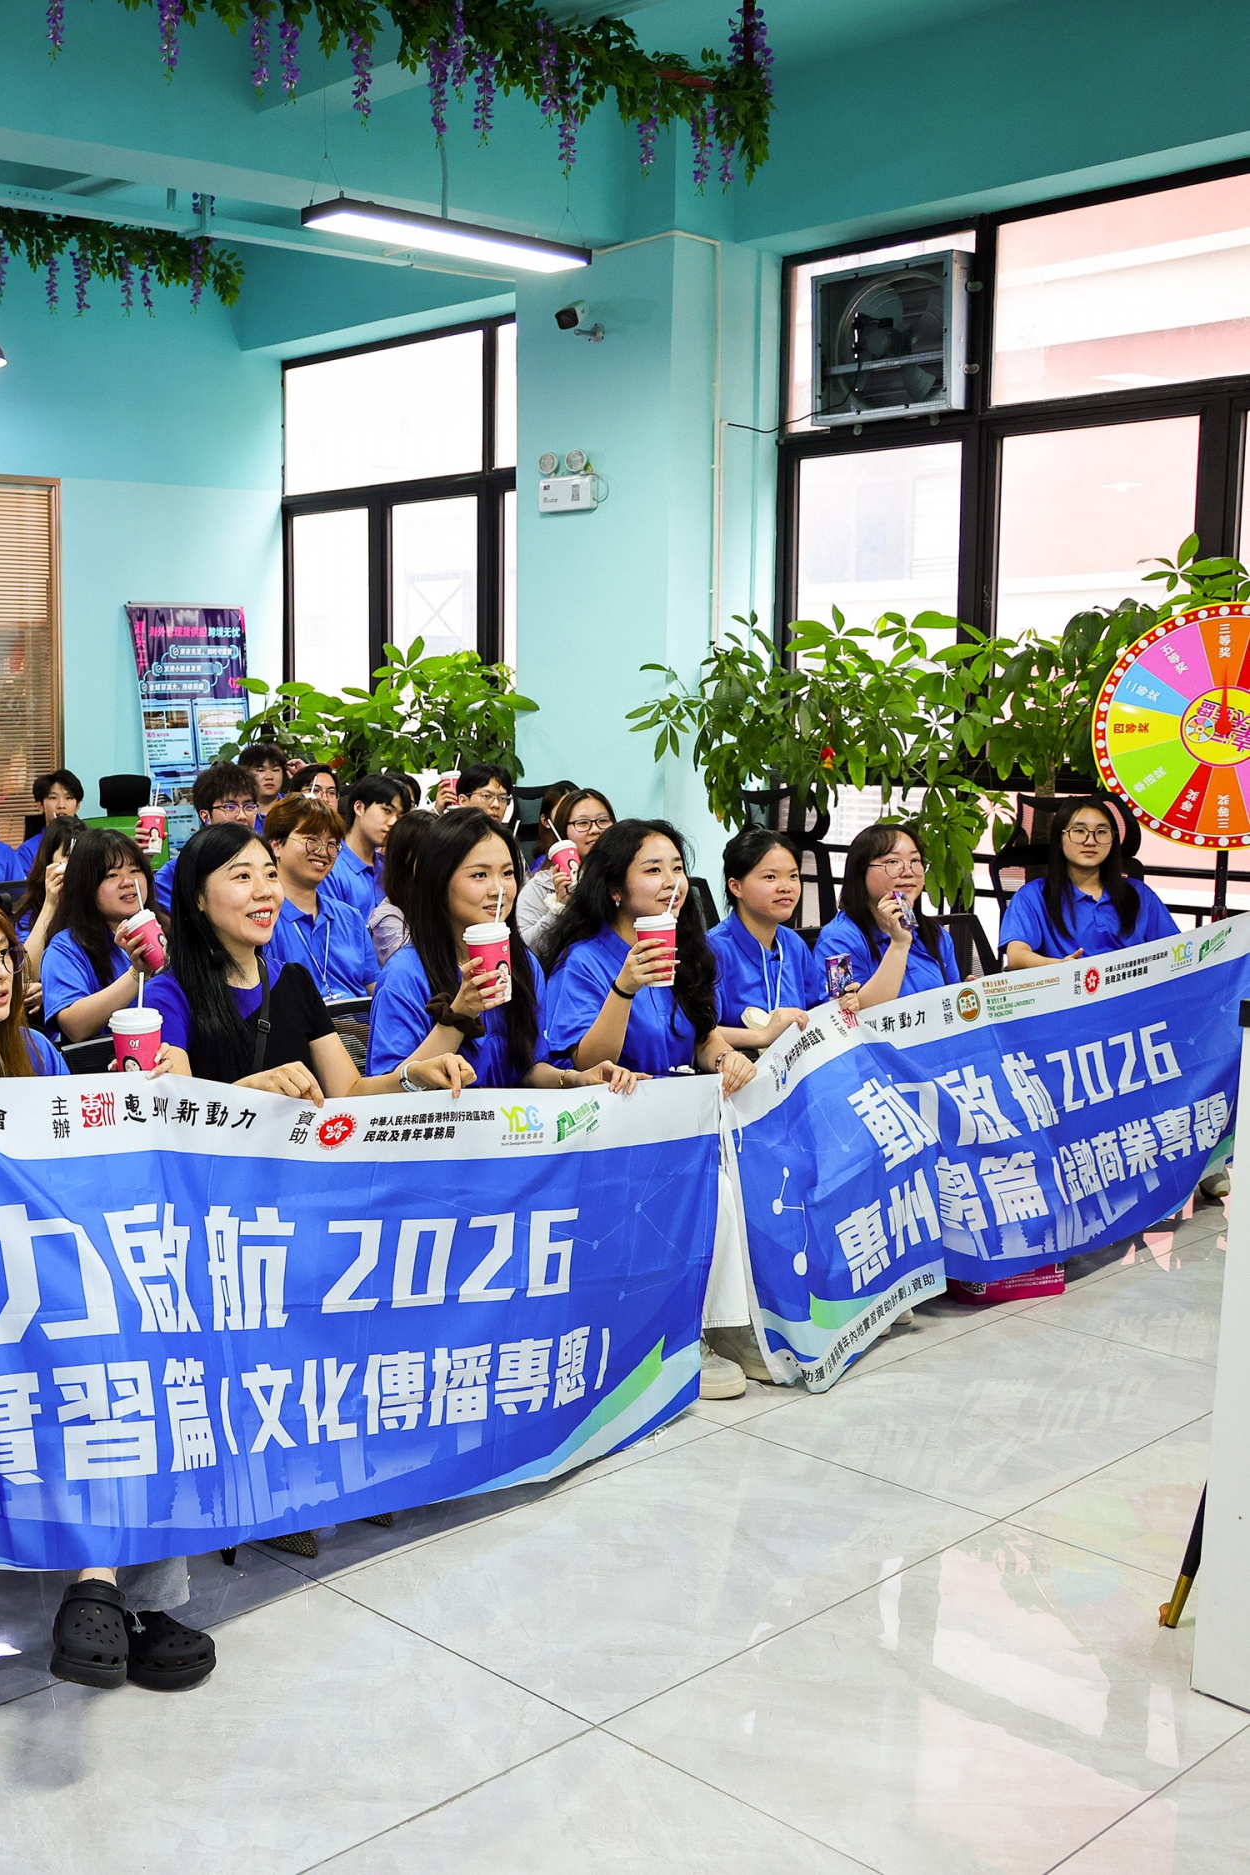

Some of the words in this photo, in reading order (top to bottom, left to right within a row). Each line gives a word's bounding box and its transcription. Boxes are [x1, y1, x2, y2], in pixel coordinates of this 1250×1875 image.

[1218, 623, 1232, 659] 三等奖
[1160, 643, 1189, 675] 五等奖
[1125, 680, 1161, 703] 二等奖
[1113, 723, 1150, 734] 四等奖
[1176, 789, 1200, 820] 一等奖
[1217, 795, 1230, 829] 三等奖
[51, 1096, 71, 1140] 主辦
[123, 1093, 257, 1129] 惠州新動力
[369, 1110, 495, 1127] 中華人民共和國香港特別行政區政府
[289, 1111, 316, 1145] 資助
[362, 1125, 455, 1142] 民政及青年事務局
